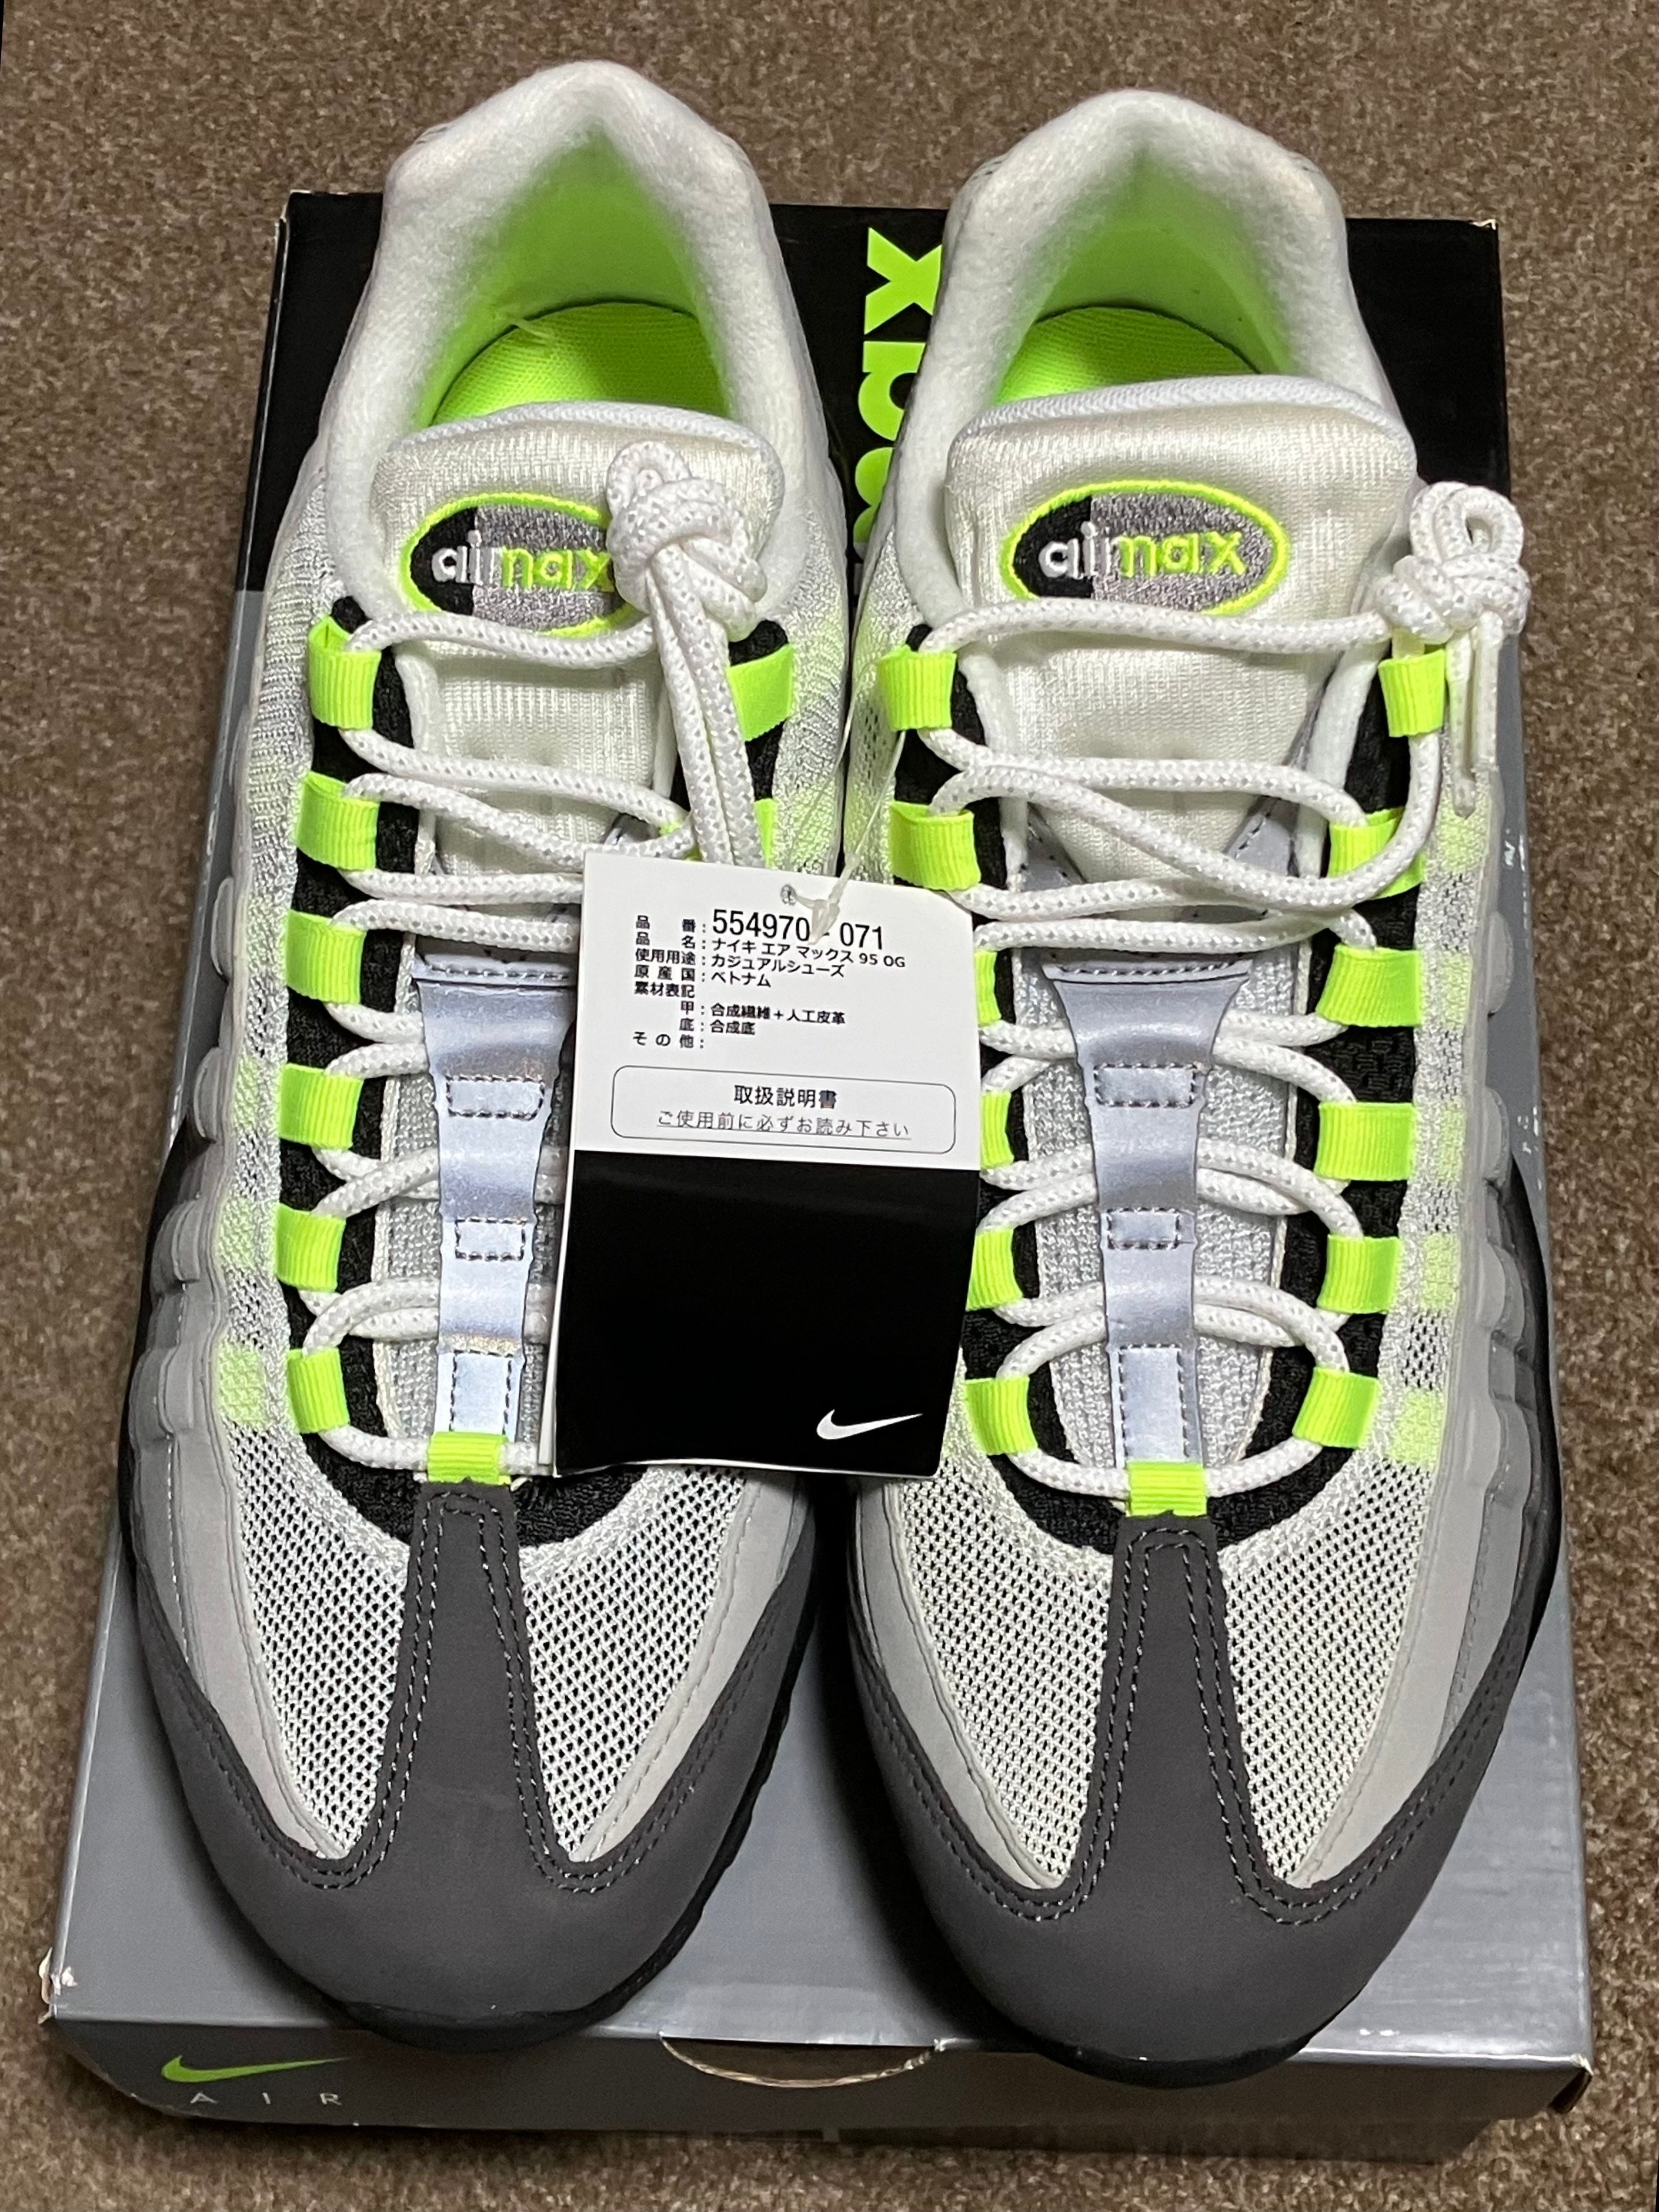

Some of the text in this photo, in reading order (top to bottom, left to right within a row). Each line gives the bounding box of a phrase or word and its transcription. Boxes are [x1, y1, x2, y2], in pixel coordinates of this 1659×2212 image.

[712, 909, 810, 941] 554970
[840, 922, 882, 950] 071
[712, 937, 756, 954] ナイキ
[761, 943, 790, 957] エア
[796, 945, 854, 964] マックス
[859, 953, 878, 965] 95
[883, 955, 906, 968] OG
[711, 954, 845, 978] カジュアルシューズ
[634, 981, 695, 998] 素材表記
[711, 970, 772, 988] ベトナム
[710, 1019, 756, 1035] 合成底
[733, 1084, 837, 1110] 取扱説明書
[657, 1109, 909, 1137] ご使用前に必ずお読み下さい
